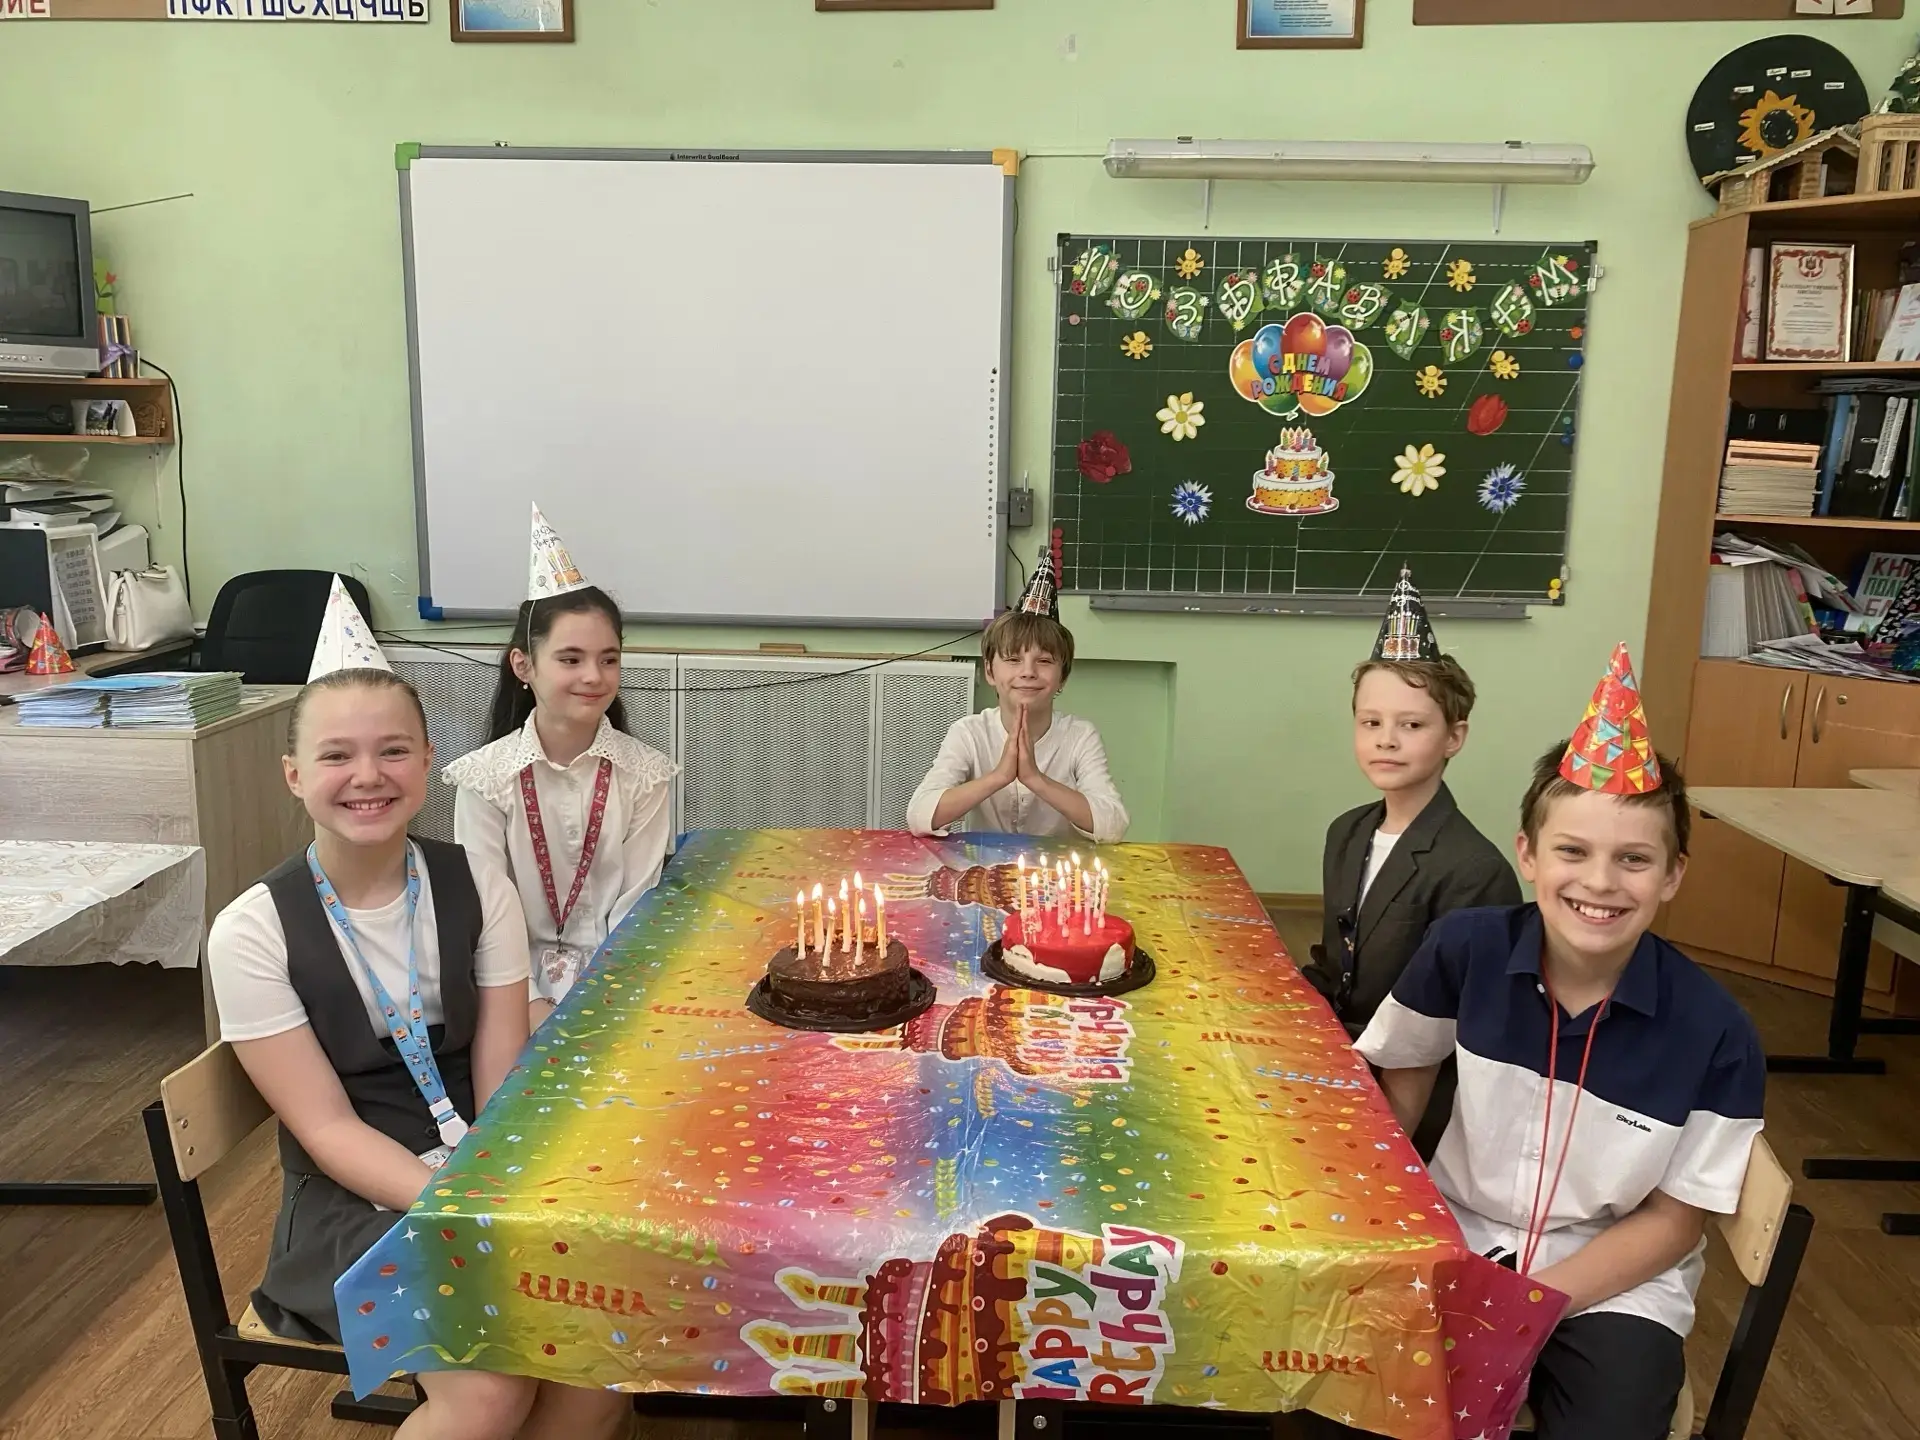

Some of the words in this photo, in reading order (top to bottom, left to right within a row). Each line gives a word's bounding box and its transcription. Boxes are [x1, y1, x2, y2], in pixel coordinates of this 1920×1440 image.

[1078, 246, 1580, 362] ПОЗДРАВЛЯЕМ
[1268, 354, 1282, 375] С
[1282, 352, 1331, 376] ДНЕМ
[1250, 374, 1349, 401] РОЖДЕНИЯ
[1615, 1113, 1652, 1133] SkyLake
